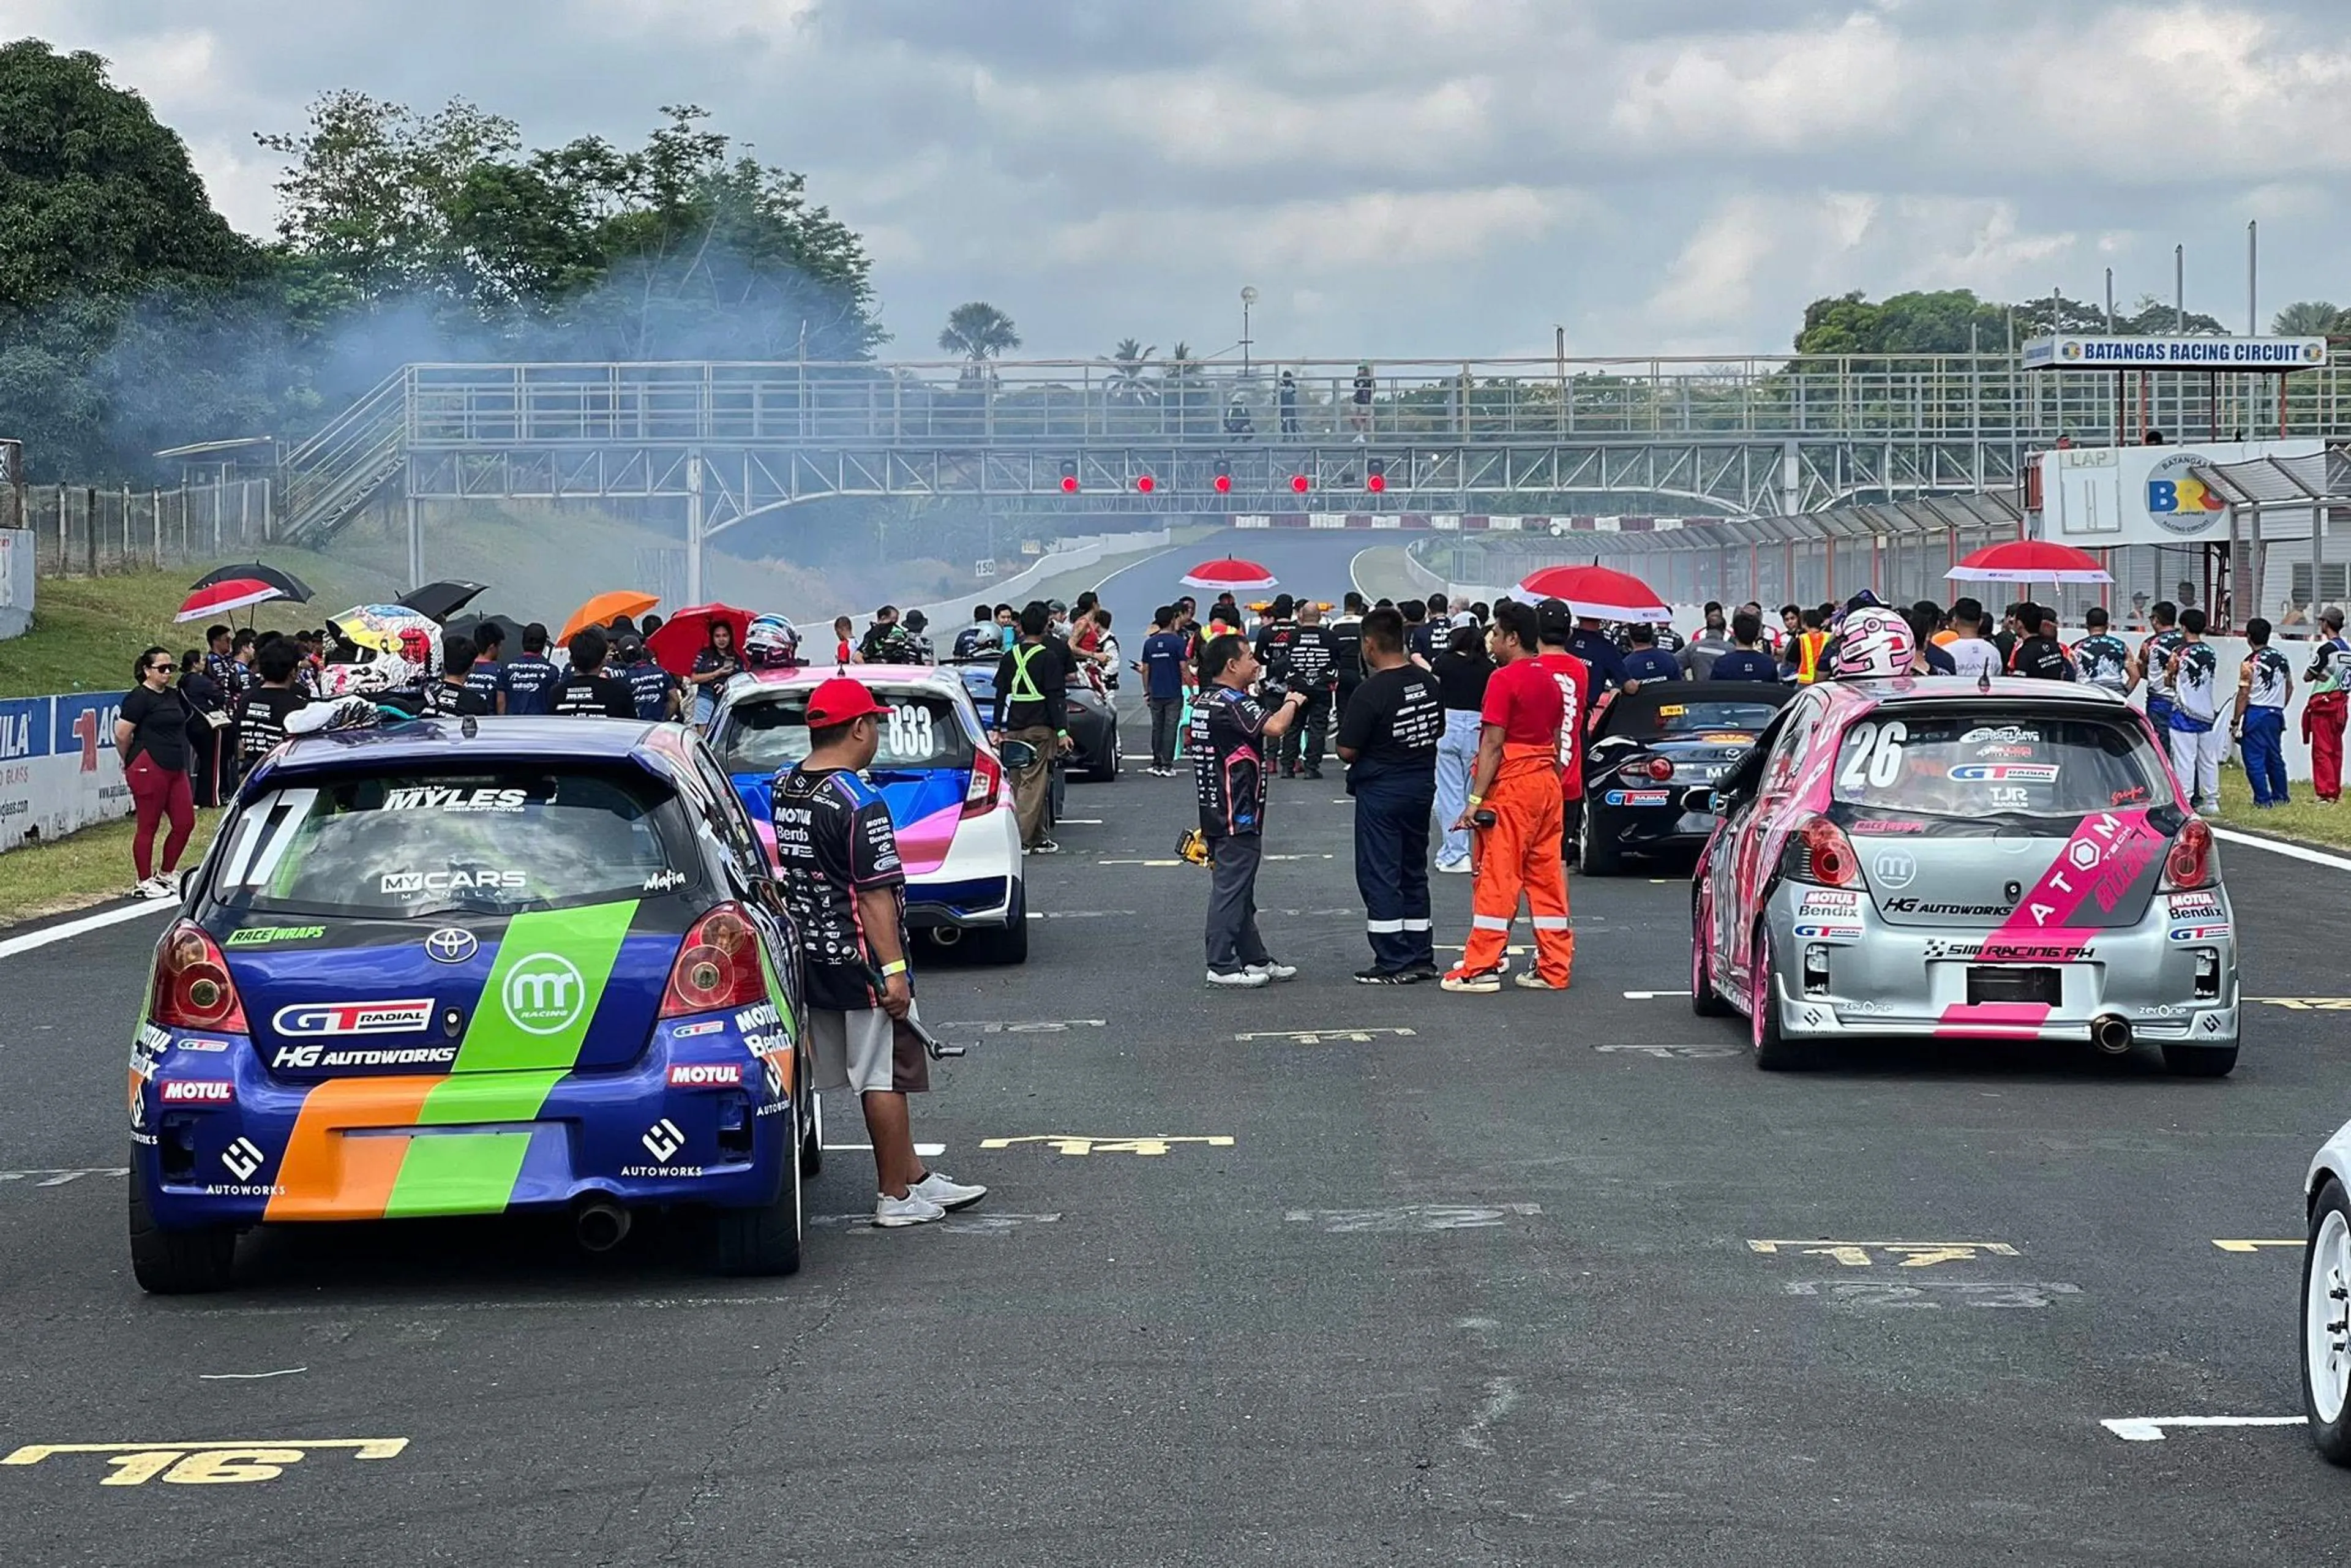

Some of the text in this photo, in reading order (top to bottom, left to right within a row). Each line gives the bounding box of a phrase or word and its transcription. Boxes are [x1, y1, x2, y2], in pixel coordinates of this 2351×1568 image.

[2084, 343, 2300, 361] BATANGAS RACING CIRCUIT
[2071, 451, 2107, 467] LAP
[977, 562, 994, 574] 150
[888, 704, 934, 757] 833
[1839, 721, 1908, 789] 26
[1953, 766, 2008, 779] GT
[389, 786, 432, 795] powered
[1989, 786, 2028, 801] TJR
[380, 789, 527, 812] MYLES
[223, 788, 320, 888] 17
[643, 869, 686, 891] Mafia
[401, 890, 503, 901] MANILA
[1805, 892, 1854, 904] MOTUL
[2170, 893, 2214, 907] MOTUL
[1798, 904, 1859, 917] Bendix
[1882, 897, 2014, 917] HG AUTOWORKS
[2168, 906, 2224, 920] Bendix
[1794, 925, 1830, 937] GT
[2170, 928, 2205, 940] GT
[1946, 944, 2095, 959] SIM RACING PH
[276, 1003, 424, 1032] GT RADIAL
[520, 1010, 569, 1019] RACING
[272, 1045, 457, 1068] HG AUTOWORKS
[671, 1066, 740, 1083] MOTUL
[165, 1082, 231, 1100] MOTUL
[621, 1165, 702, 1177] AUTOWORKS
[206, 1184, 286, 1196] AUTOWORKS
[99, 1449, 306, 1485] 16
